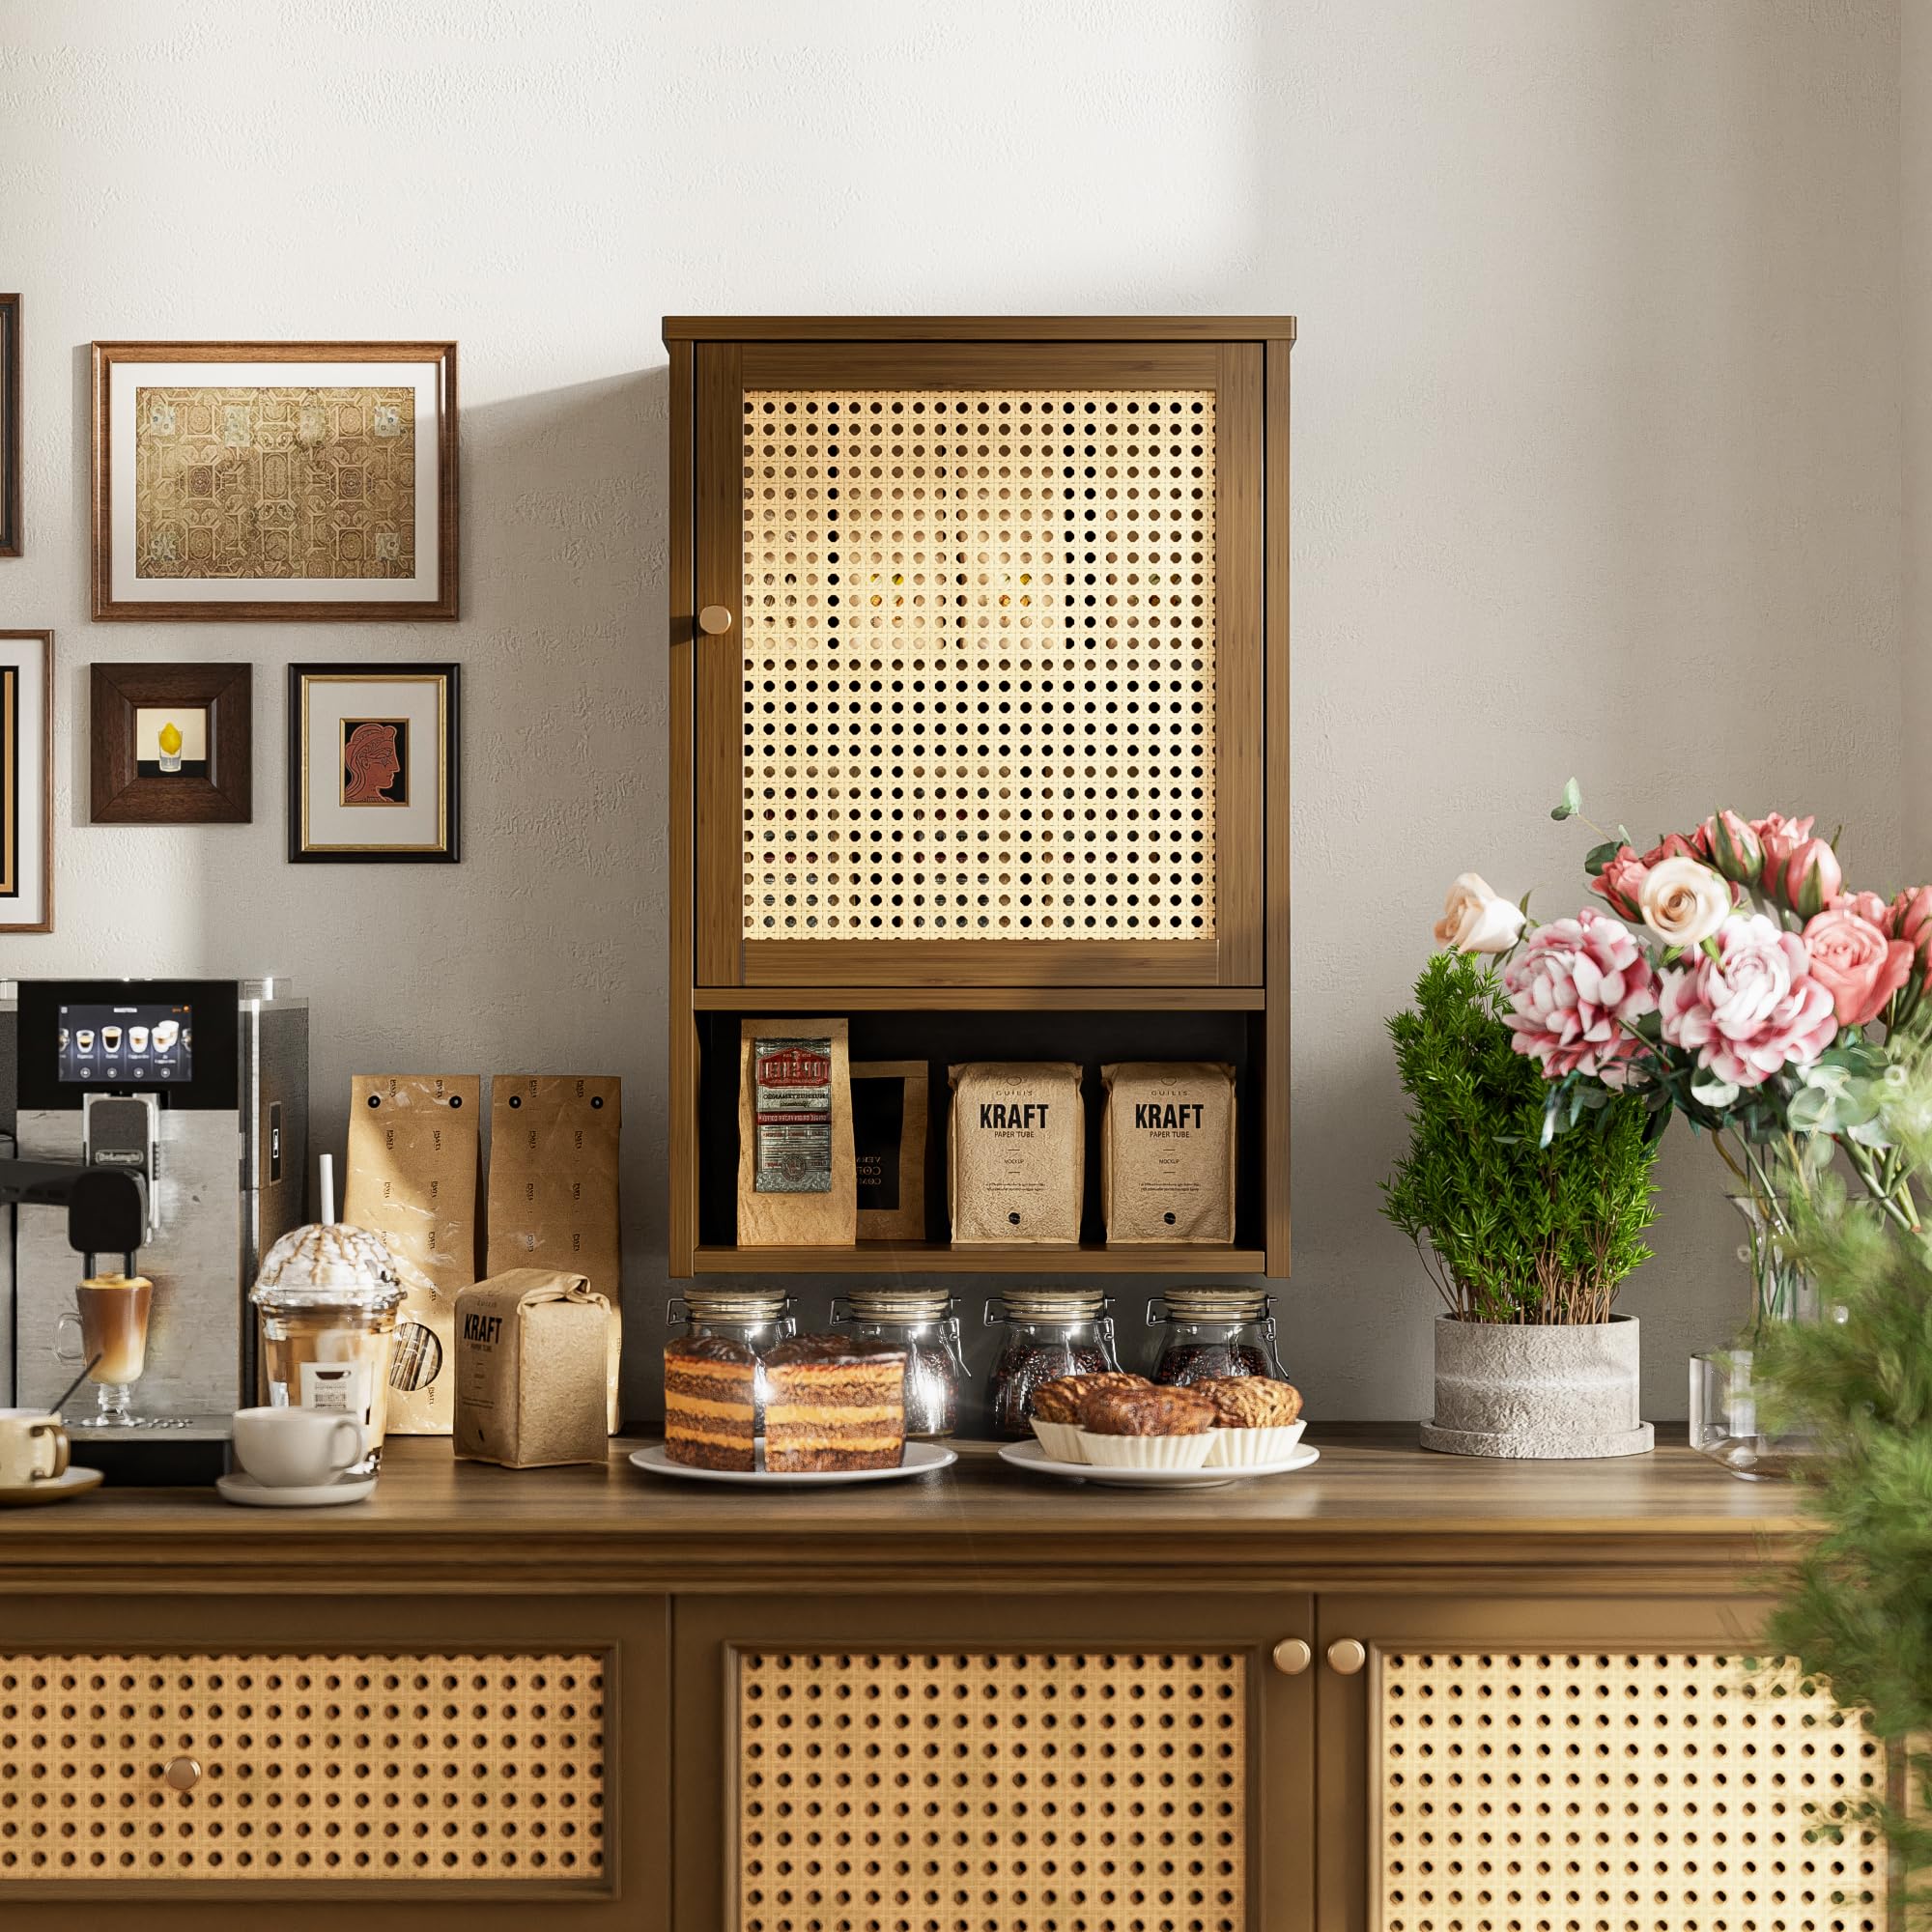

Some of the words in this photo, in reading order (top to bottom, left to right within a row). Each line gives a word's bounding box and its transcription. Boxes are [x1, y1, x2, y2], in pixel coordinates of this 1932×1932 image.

[980, 1103, 1049, 1129] KRAFT
[1135, 1103, 1205, 1129] KRAFT
[464, 1313, 503, 1345] KRAFT
